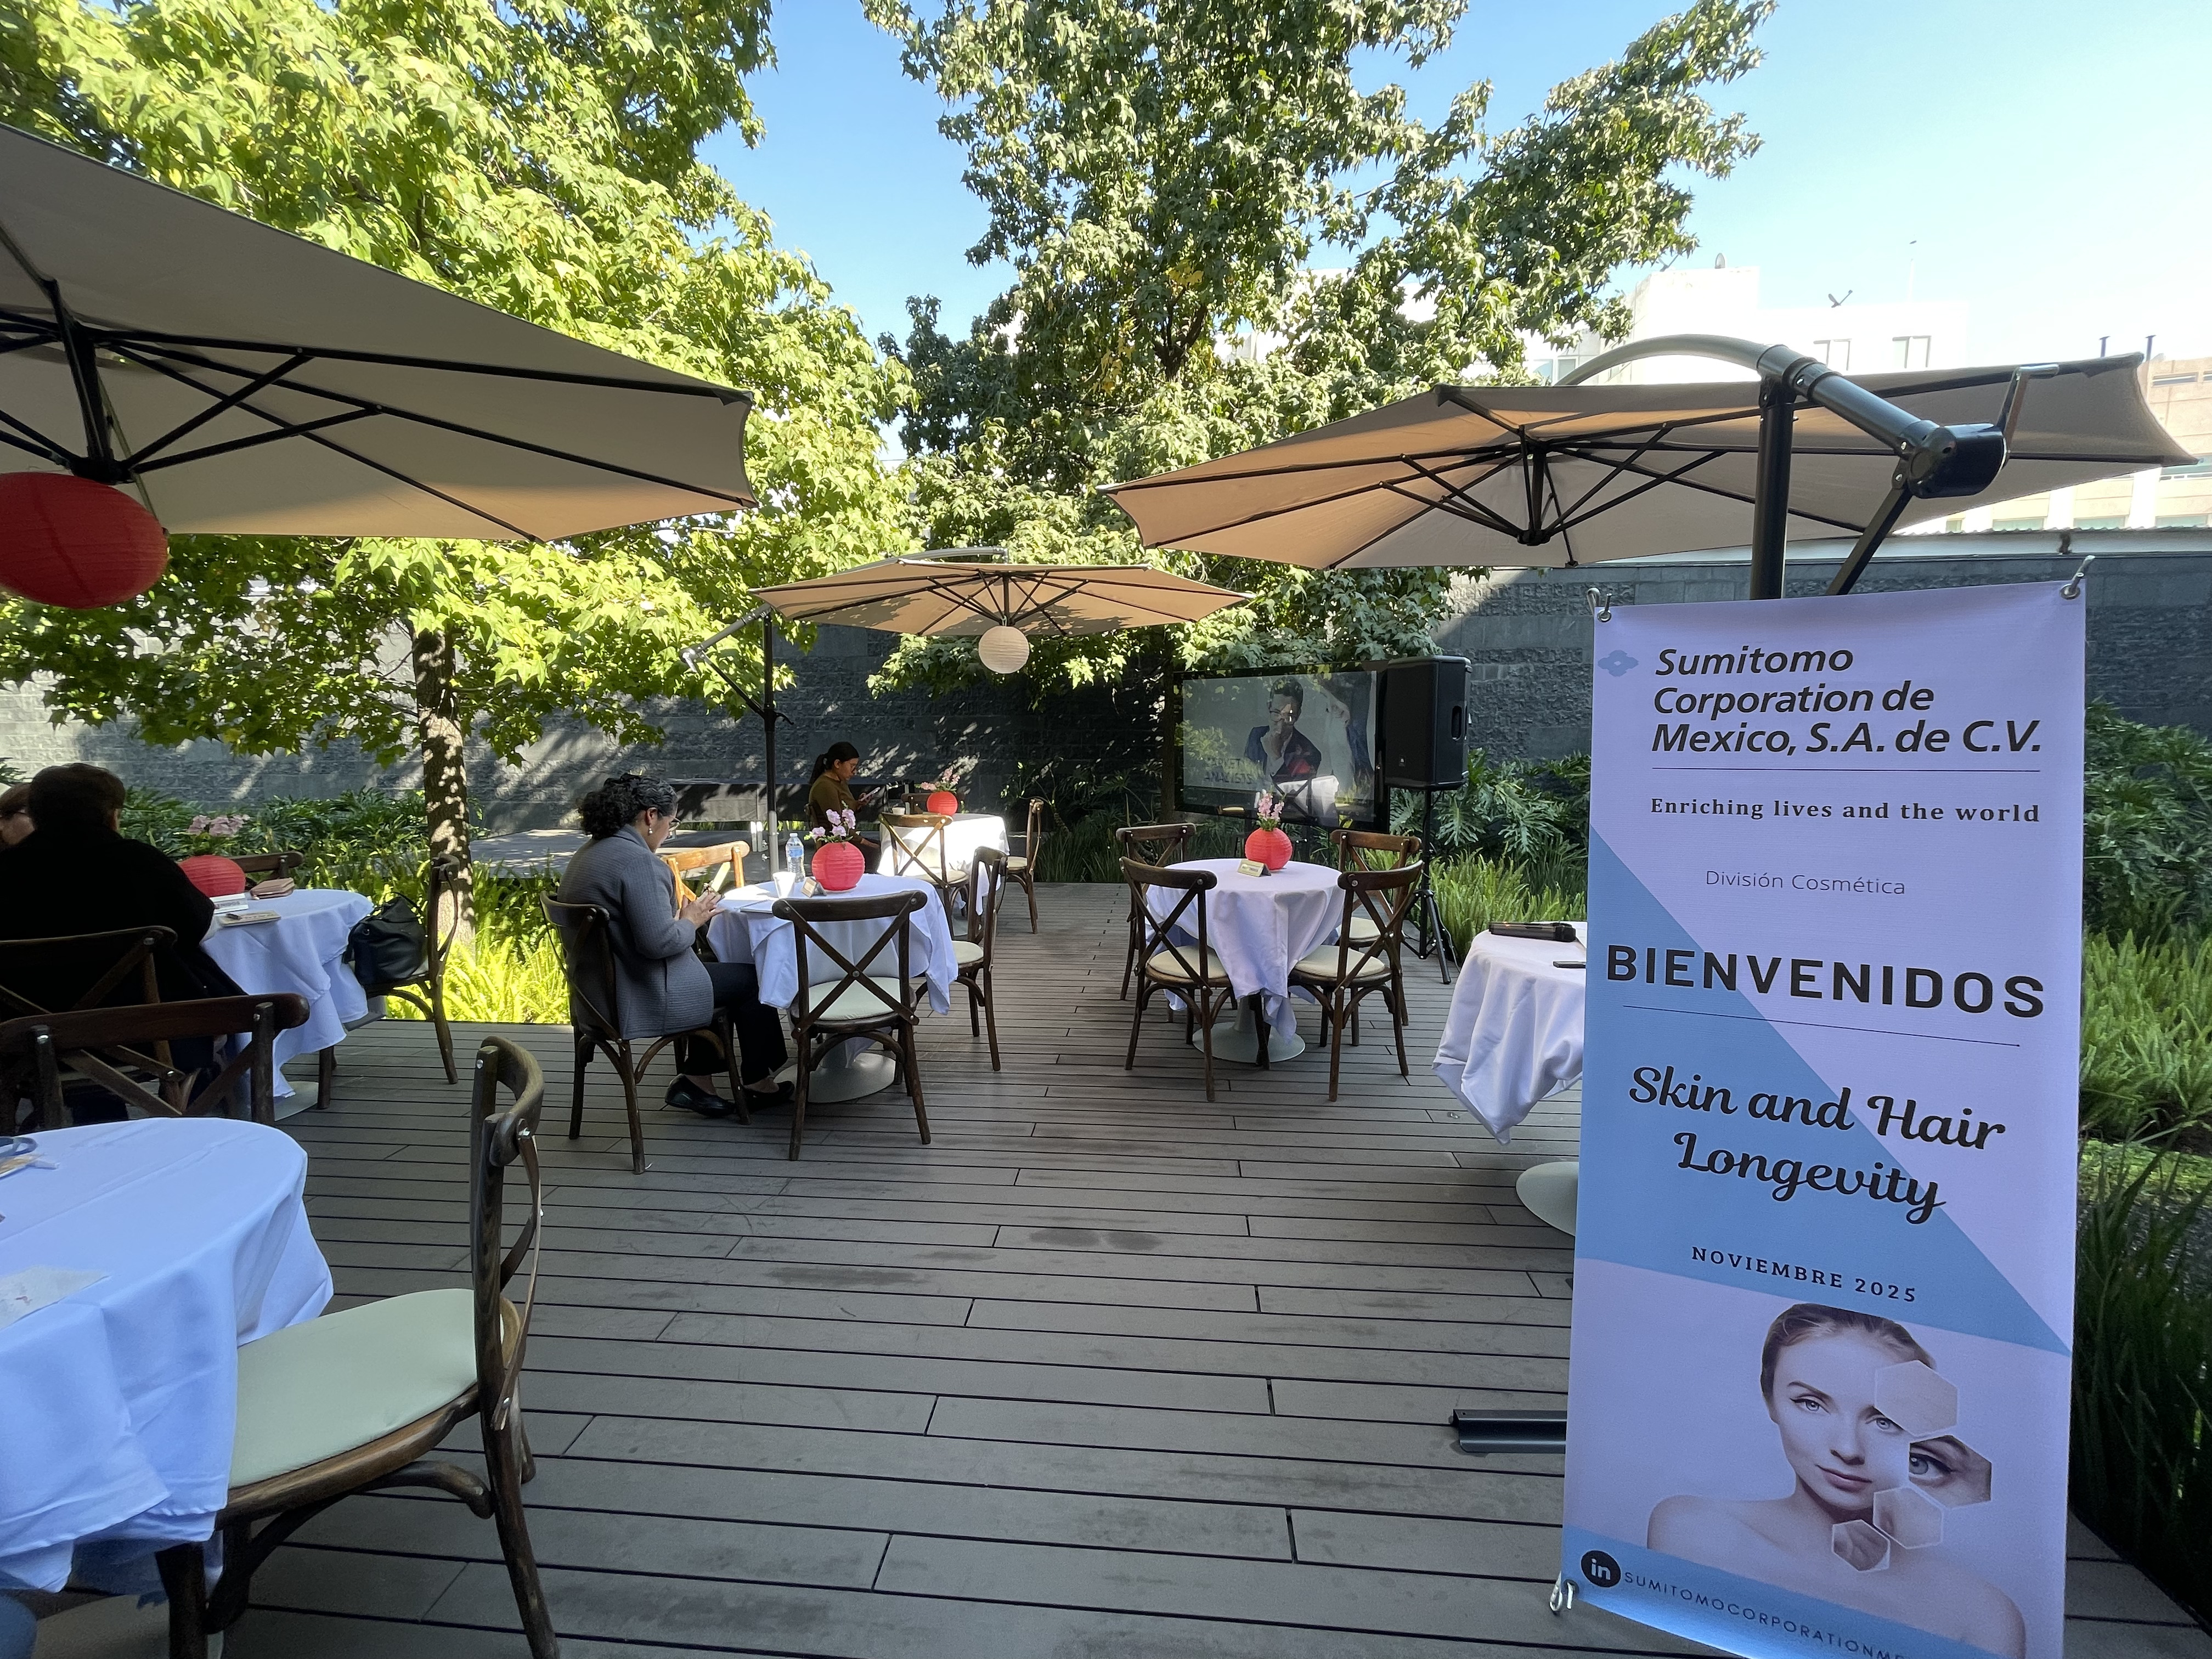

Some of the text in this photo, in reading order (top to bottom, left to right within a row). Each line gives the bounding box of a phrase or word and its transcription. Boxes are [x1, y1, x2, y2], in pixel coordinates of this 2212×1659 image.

[1655, 645, 1854, 676] Sumitomo
[1654, 680, 1935, 721] Corporation de
[1652, 719, 2041, 756] Mexico, S.A. de C.V.
[1651, 798, 2040, 822] Enriching lives and the world
[1707, 870, 1905, 895] División Cosmética
[1607, 945, 2044, 1018] BIENVENIDOS
[1629, 1065, 2006, 1150] Skin and Hair
[1673, 1132, 1946, 1224] Longevity
[1692, 1246, 1916, 1304] NOVIEMBRE 2025
[1591, 1558, 1906, 1659] in SUMITOMOCORPORATIONM
